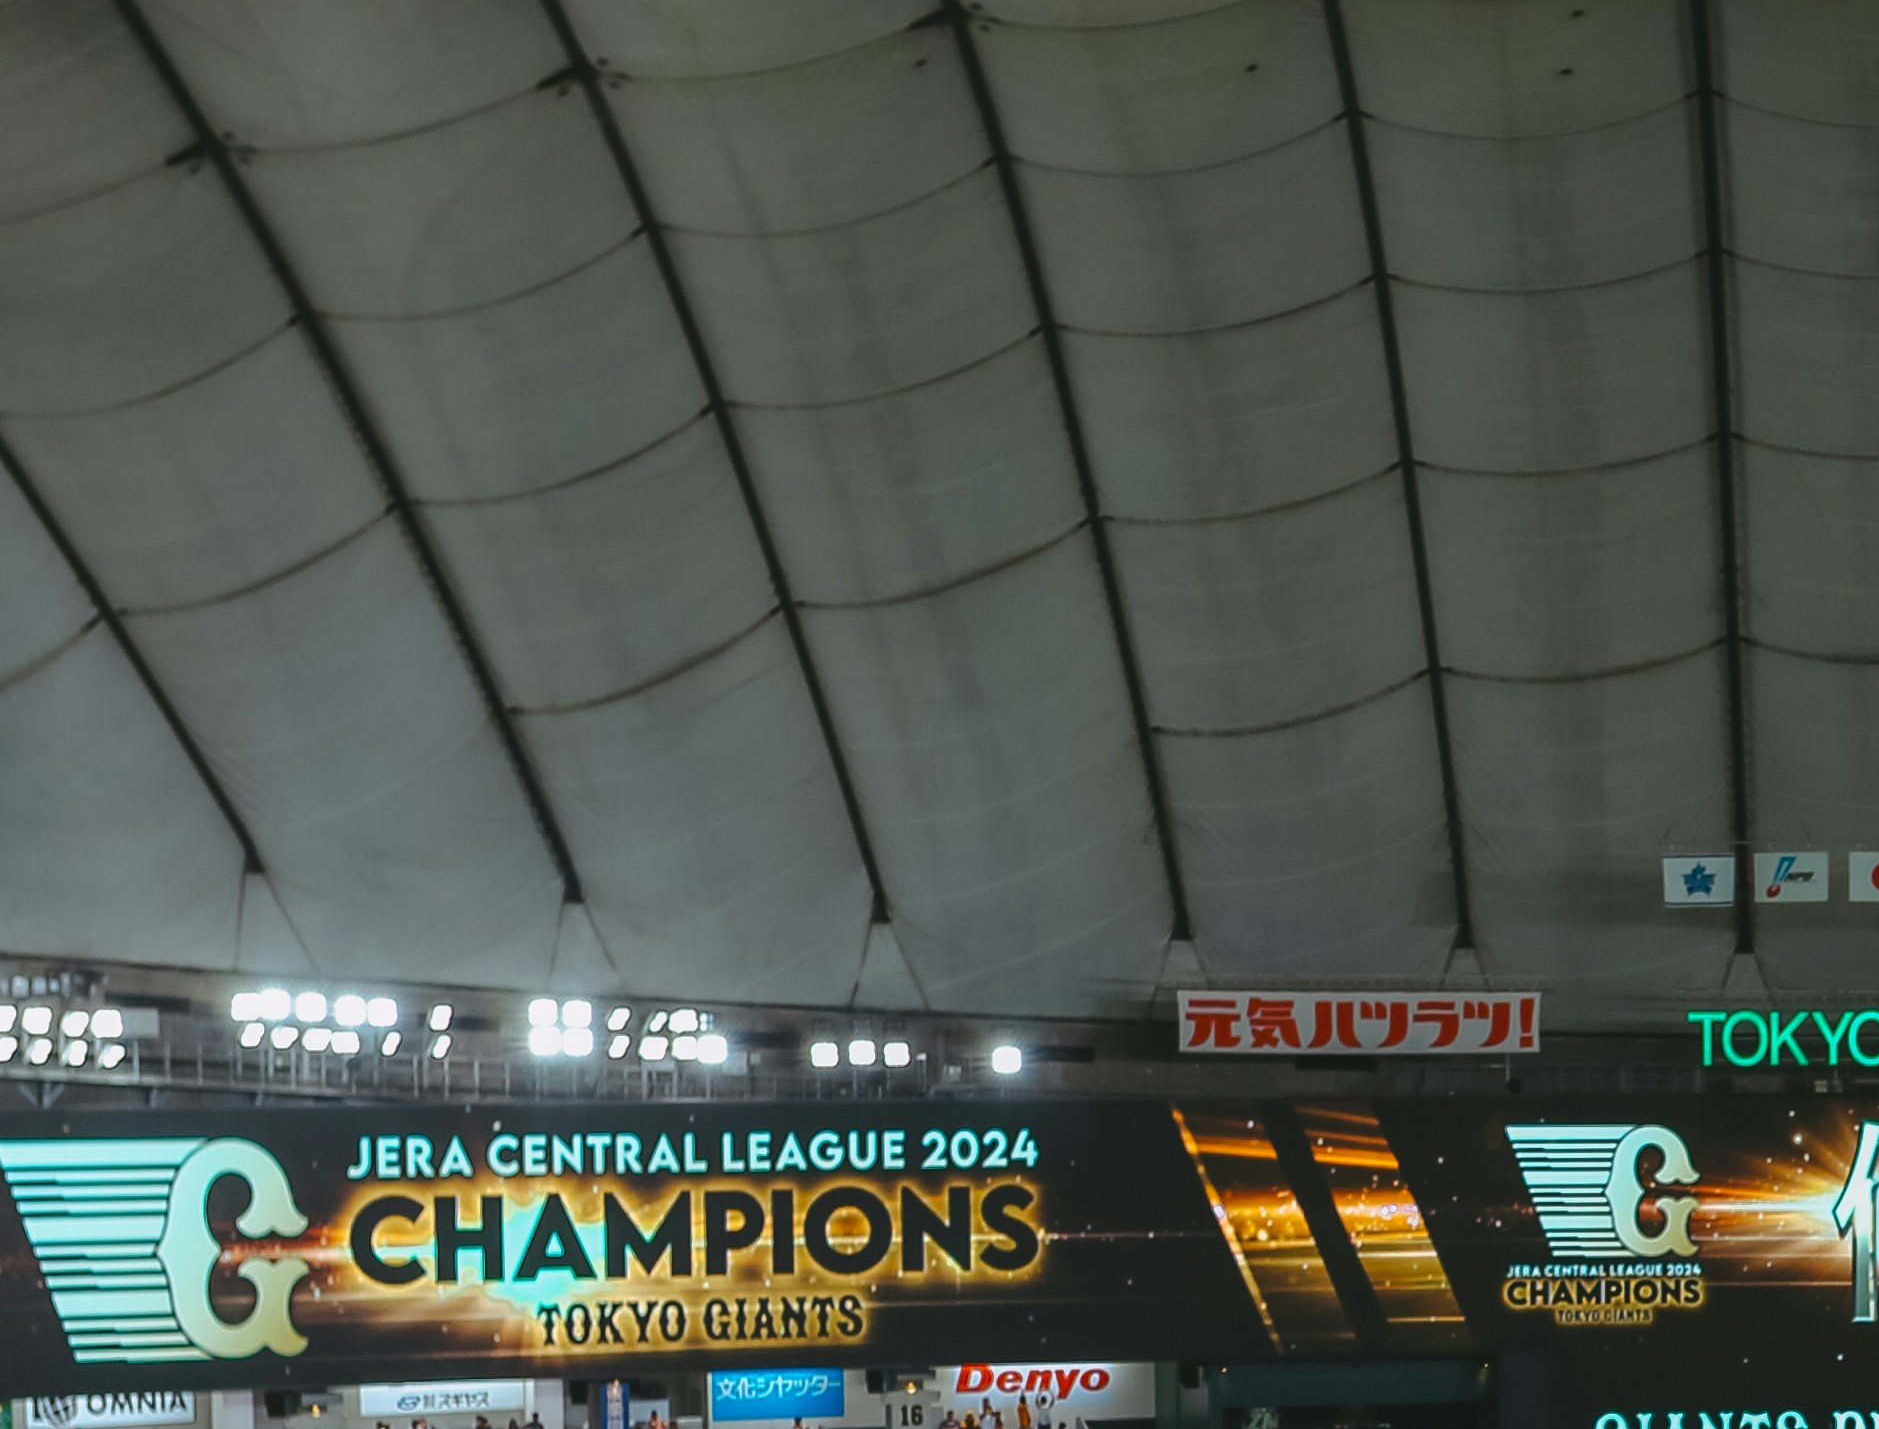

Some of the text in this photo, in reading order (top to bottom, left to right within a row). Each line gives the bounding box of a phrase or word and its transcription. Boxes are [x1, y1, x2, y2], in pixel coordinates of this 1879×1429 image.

[347, 1127, 1040, 1180] JERA CENTRAL LEAGUE 2024
[349, 1183, 1041, 1285] CHAMPIONS
[1506, 1262, 1702, 1279] JERA CENTRAL LEAGUE 2024
[1505, 1278, 1702, 1306] CHAMPIONS
[537, 1294, 864, 1346] TOKYO GIANTS
[1556, 1308, 1650, 1323] TOKYO GIANTS
[955, 1362, 1111, 1399] Denyo
[86, 1390, 188, 1415] OMNIA
[900, 1404, 924, 1427] 16
